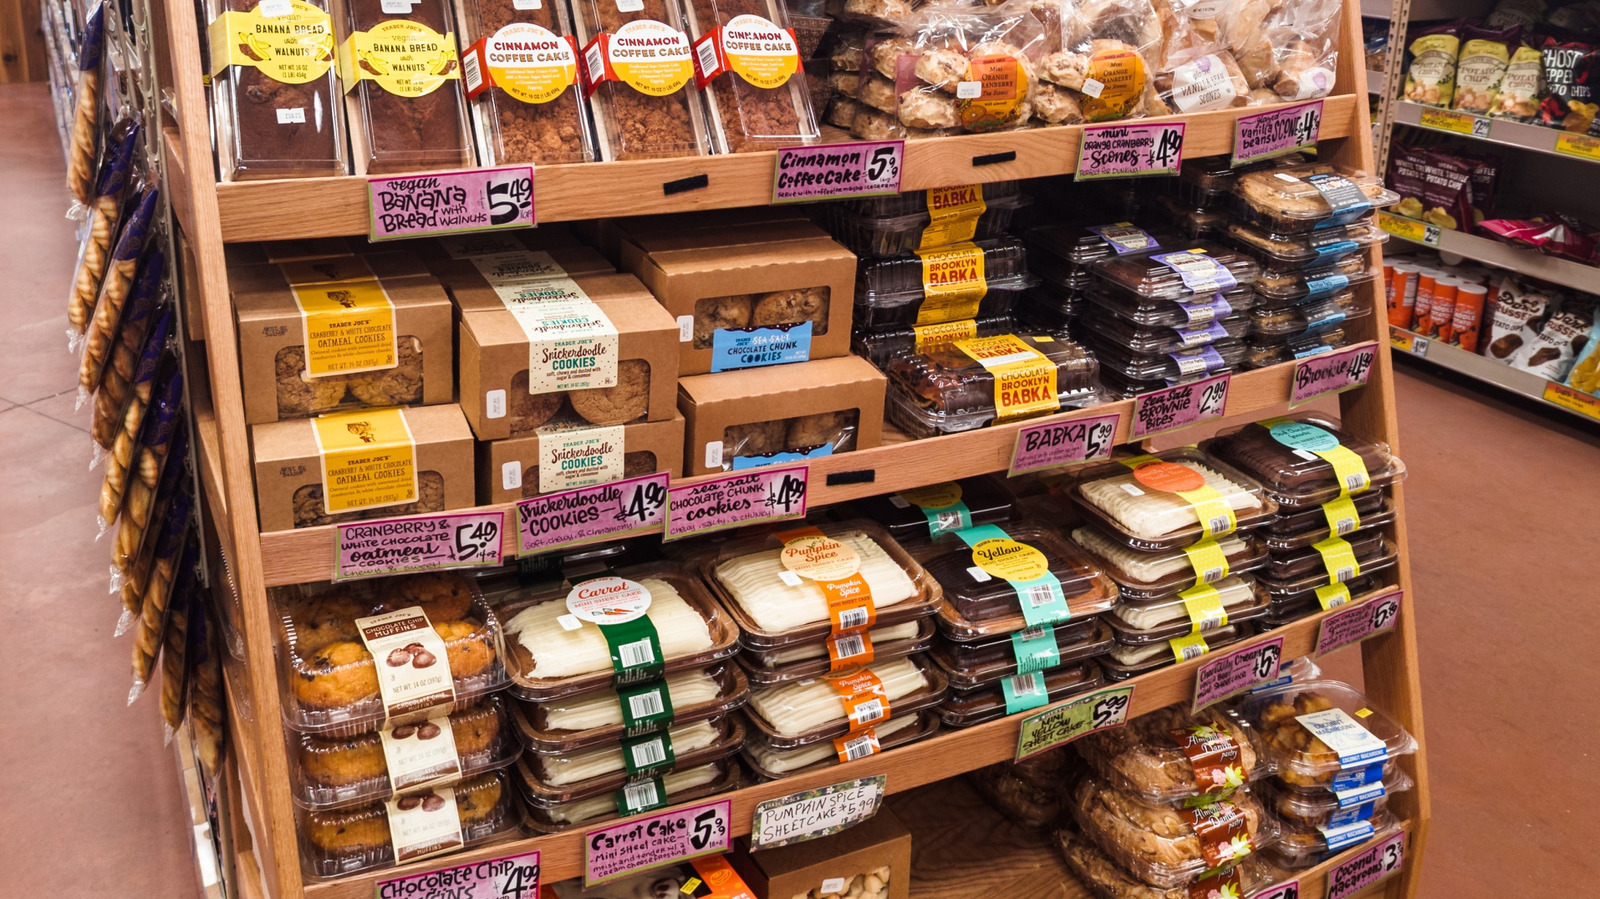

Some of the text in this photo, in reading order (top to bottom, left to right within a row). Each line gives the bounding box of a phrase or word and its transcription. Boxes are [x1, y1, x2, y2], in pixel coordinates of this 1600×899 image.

[256, 24, 324, 34] BANANA BREAD
[728, 31, 782, 40] CINNAMON
[374, 43, 438, 52] BANANA BREAD
[494, 41, 559, 50] CINNAMON
[617, 36, 680, 47] CINNAMON
[726, 41, 792, 51] COFFEE CAKE
[274, 48, 310, 56] WALNUTS
[490, 51, 570, 63] COFFEE CAKE
[612, 44, 690, 58] COFFEE CAKE
[392, 63, 426, 72] WALNUTS
[1463, 74, 1490, 82] CHIPS
[1180, 81, 1211, 96] VANILLA
[1571, 86, 1591, 97] CHIPS
[1199, 90, 1221, 106] SCONES
[1097, 127, 1129, 139] mini
[780, 152, 861, 169] Cinnamon
[1090, 150, 1140, 168] Scones
[1424, 165, 1469, 183] WHITE TRUFFLE
[1426, 175, 1448, 187] POTATO
[387, 178, 441, 193] vegan
[933, 189, 978, 210] BABKA
[441, 204, 467, 215] with
[928, 250, 976, 261] CHOCOLATE
[930, 258, 977, 272] BROOKLYN
[929, 268, 978, 287] BABKA
[310, 324, 392, 339] CRANBERRY WHITE CHOCOLATE
[318, 333, 386, 348] OATMEAL COOKIES
[752, 334, 790, 345] SEA SALT
[542, 343, 607, 363] Snickerdoodle
[727, 340, 797, 355] CHOCOLATE CHUNK
[970, 342, 1017, 353] BROOKLYN
[976, 346, 1027, 359] BABKA
[552, 357, 596, 370] COOKIES
[741, 351, 782, 363] COOKIES
[1001, 368, 1049, 381] CHOCOLATE
[1296, 361, 1348, 390] Brookie
[1001, 376, 1049, 391] BROOKLYN
[1001, 386, 1052, 407] BABKA
[1142, 386, 1193, 408] Sea Salt
[1026, 424, 1086, 452] BABKA
[551, 442, 614, 464] Snickerdoodle
[328, 466, 357, 476] CRANBERRY
[383, 460, 412, 469] CHOCOLATE
[562, 456, 603, 470] COOKIES
[337, 468, 405, 484] OATMEAL COOKIES
[688, 474, 760, 495] sea salt
[727, 484, 766, 498] CHUNK
[438, 519, 451, 530] &
[350, 543, 440, 562] oatmeal
[785, 541, 842, 558] Pumpkin
[805, 551, 838, 563] Spice
[977, 545, 1023, 560] Yellow
[578, 581, 630, 599] Carrot
[826, 580, 862, 591] Pumpkin
[840, 587, 860, 597] Spice
[365, 617, 424, 634] CHOCOLATE CHIP
[374, 624, 417, 637] MUFFINS
[839, 675, 872, 687] Pumpkin
[852, 681, 872, 690] Spice
[1032, 718, 1070, 738] YELLOW
[1041, 712, 1064, 729] MINI
[1184, 733, 1220, 749] Almond
[1201, 742, 1232, 754] Danish
[1220, 749, 1238, 763] pastry
[1342, 749, 1384, 764] COCONUT MACAROONS
[1341, 789, 1382, 805] COCONUT MACAROONS
[765, 797, 827, 824] PUMPKIN
[1192, 803, 1223, 825] Almond
[1210, 812, 1237, 828] Danish
[1228, 818, 1244, 835] pastry
[592, 818, 686, 851] Carrot Cake
[1328, 827, 1371, 844] COCONUT MACAROONS
[417, 844, 442, 855] MUFFINS
[595, 849, 618, 862] Mini
[619, 855, 635, 865] and
[1334, 847, 1379, 884] Coconut
